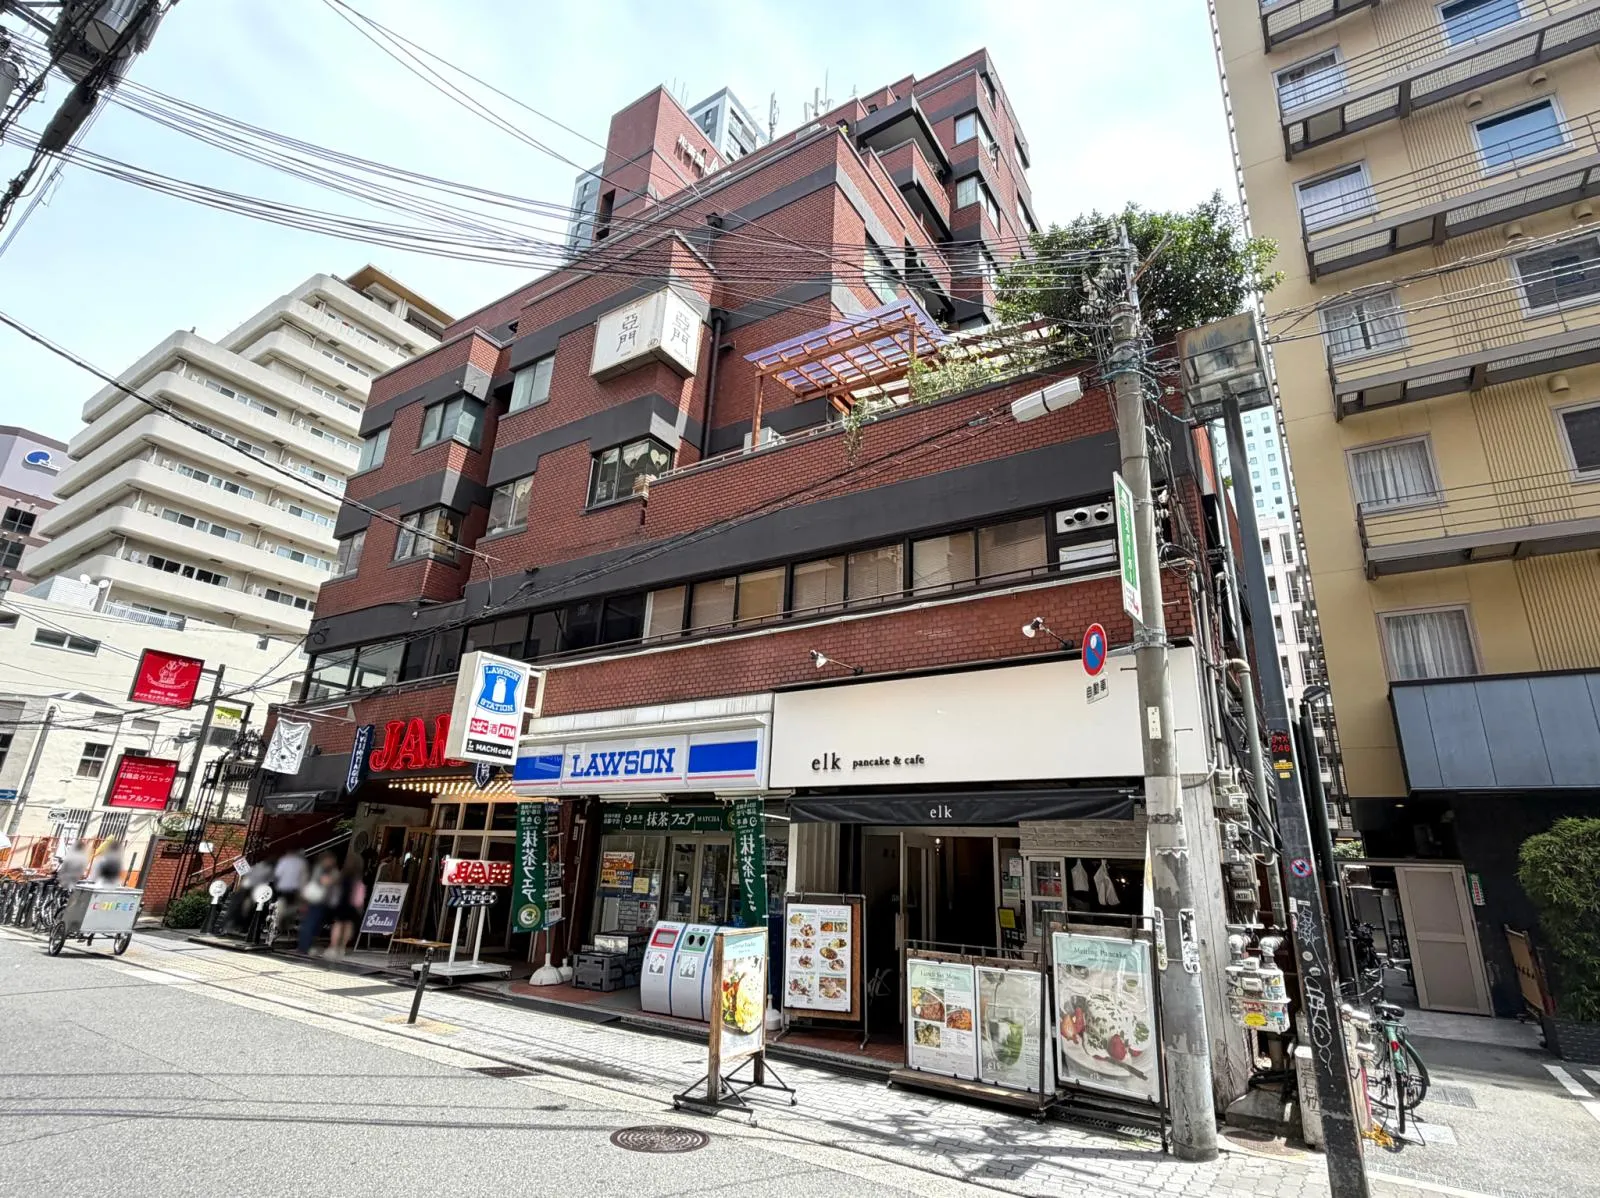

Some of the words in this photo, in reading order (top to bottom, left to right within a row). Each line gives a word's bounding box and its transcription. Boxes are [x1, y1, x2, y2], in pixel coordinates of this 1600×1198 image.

[485, 667, 520, 682] LAWSON
[480, 698, 514, 712] STATION
[499, 726, 515, 737] ATM
[476, 744, 498, 753] MACHI
[570, 748, 675, 776] LAWSON
[811, 752, 841, 771] elk
[852, 757, 890, 769] pancake
[893, 756, 901, 765] &
[904, 755, 925, 765] cafe
[930, 805, 952, 818] elk
[448, 861, 513, 884] JAM
[374, 894, 402, 904] JAM
[463, 894, 493, 902] VINTAGE
